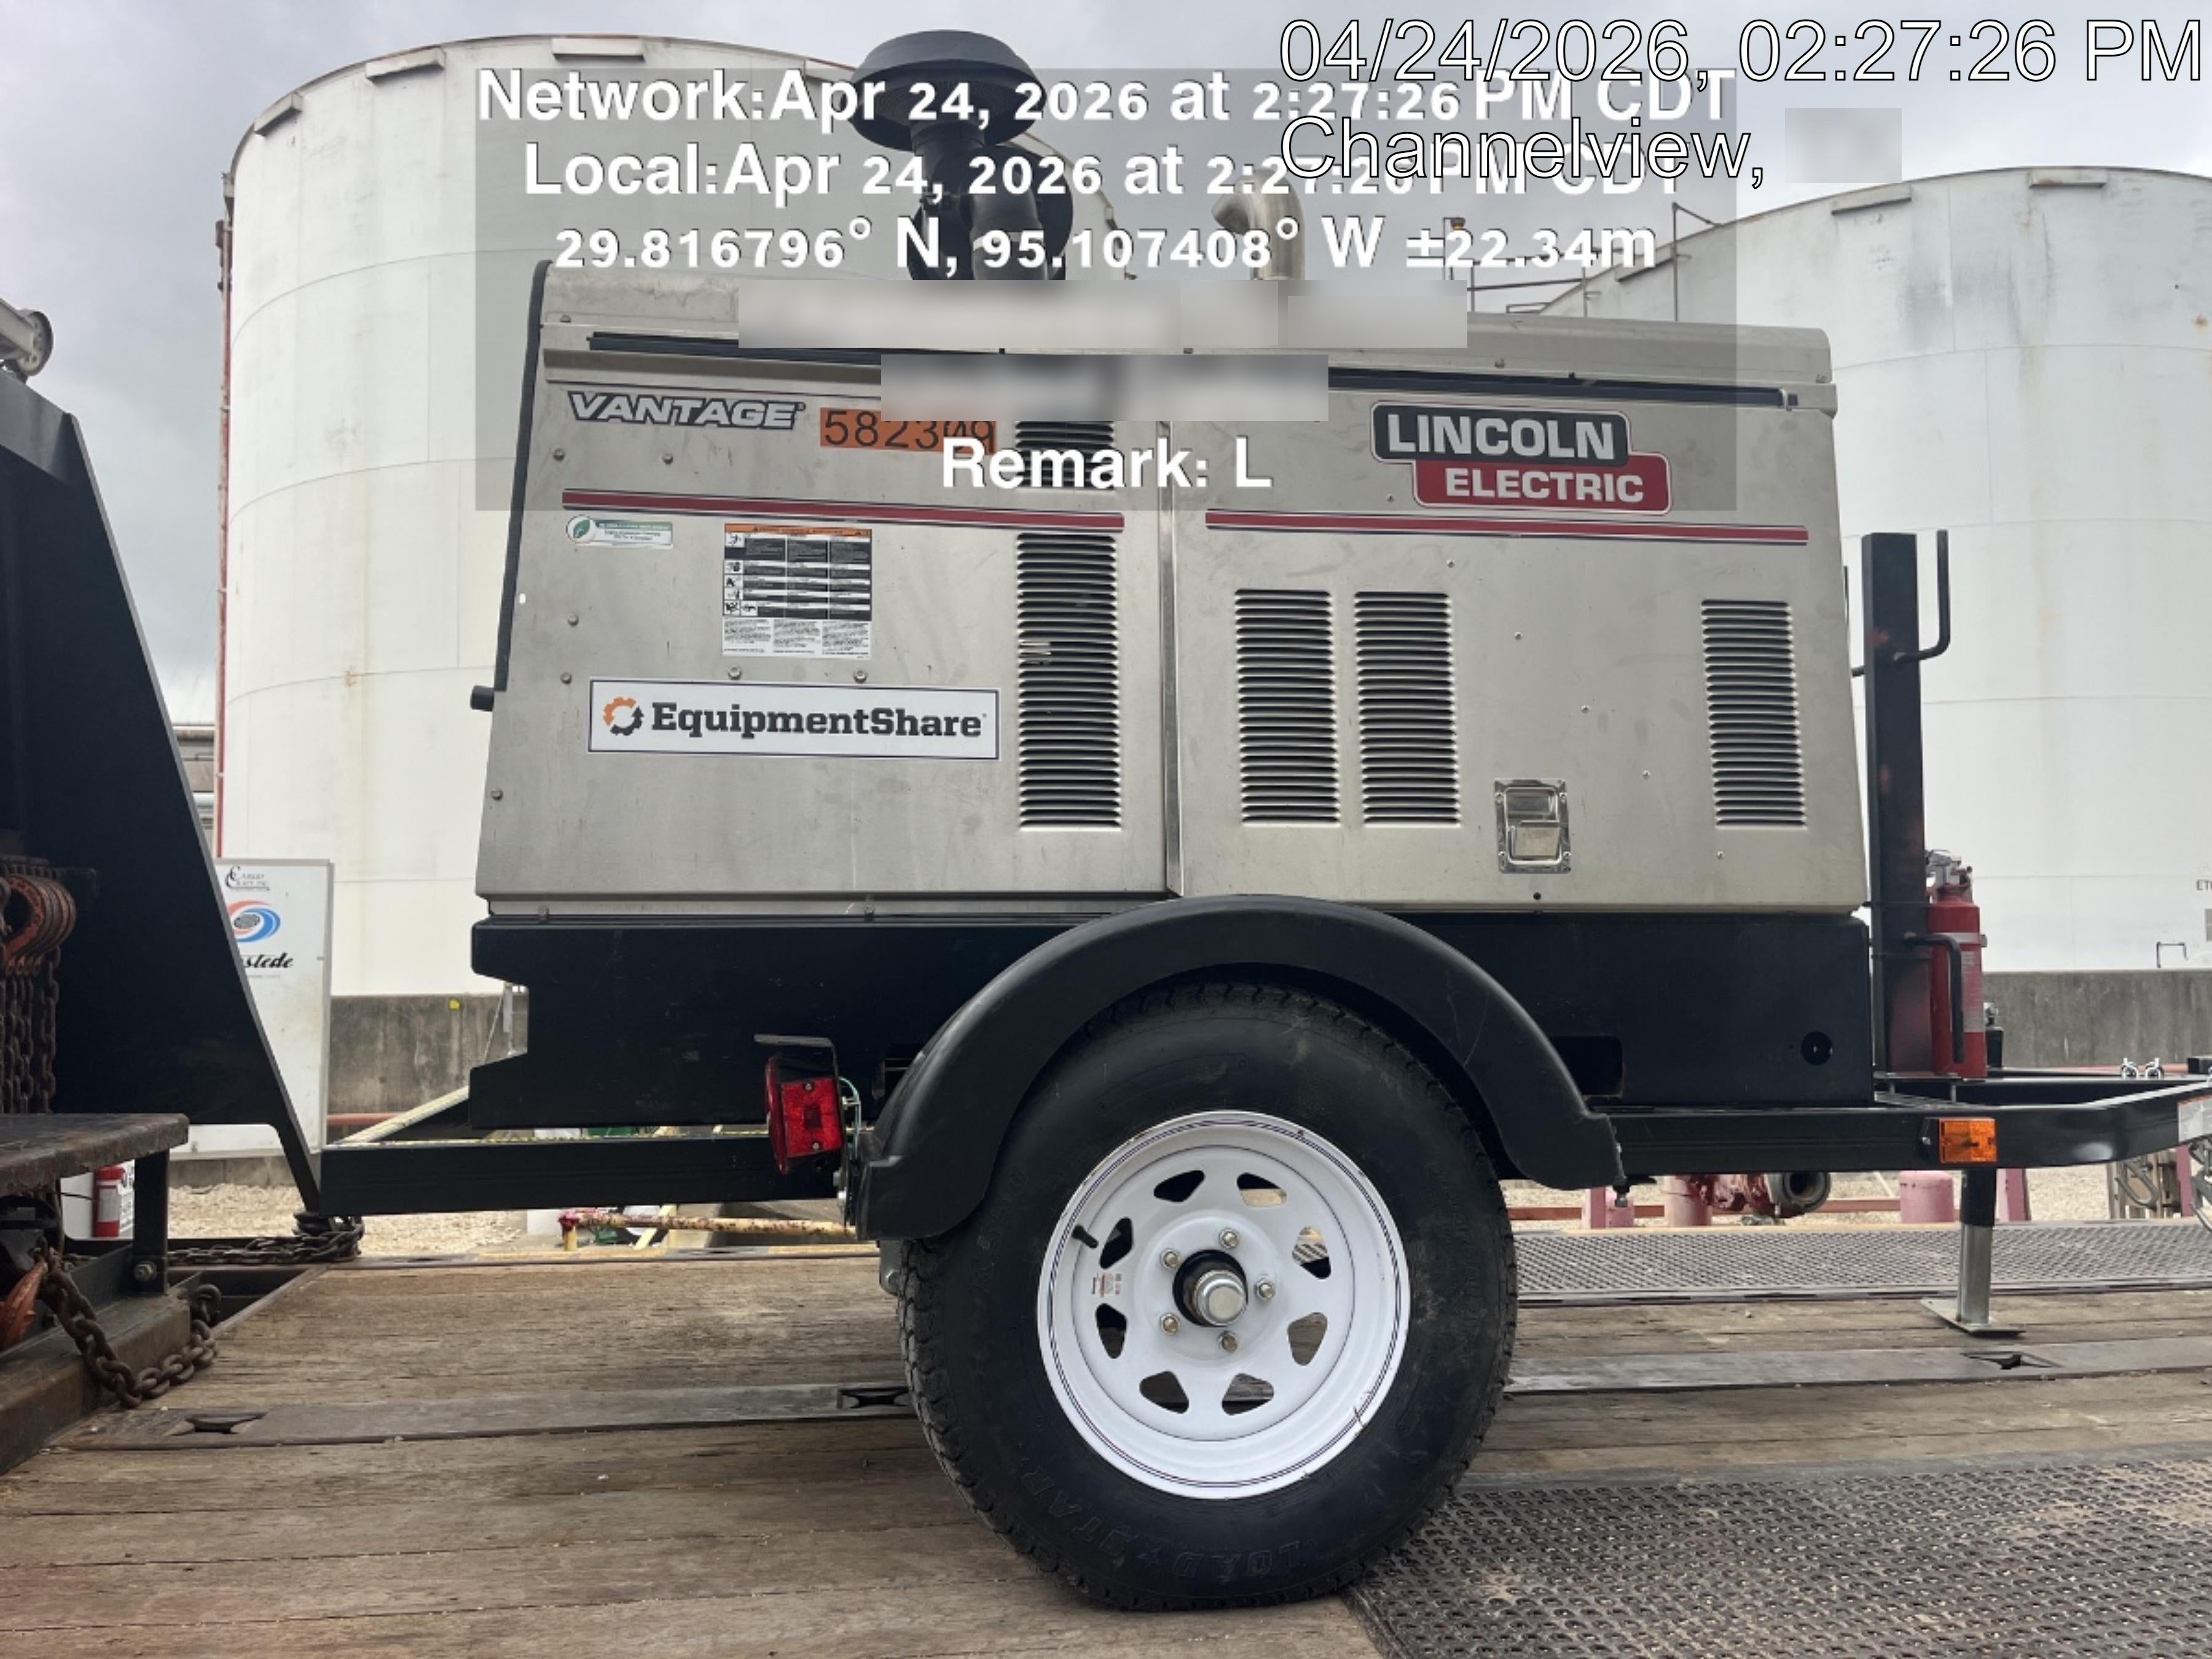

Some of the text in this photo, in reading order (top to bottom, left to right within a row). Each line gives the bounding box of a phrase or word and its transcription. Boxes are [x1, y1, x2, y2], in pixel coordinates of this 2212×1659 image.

[1387, 414, 1615, 460] LINCOLN
[1445, 468, 1644, 503] ELECTRIC
[652, 702, 982, 739] EquipmentShare
[243, 952, 294, 968] stede
